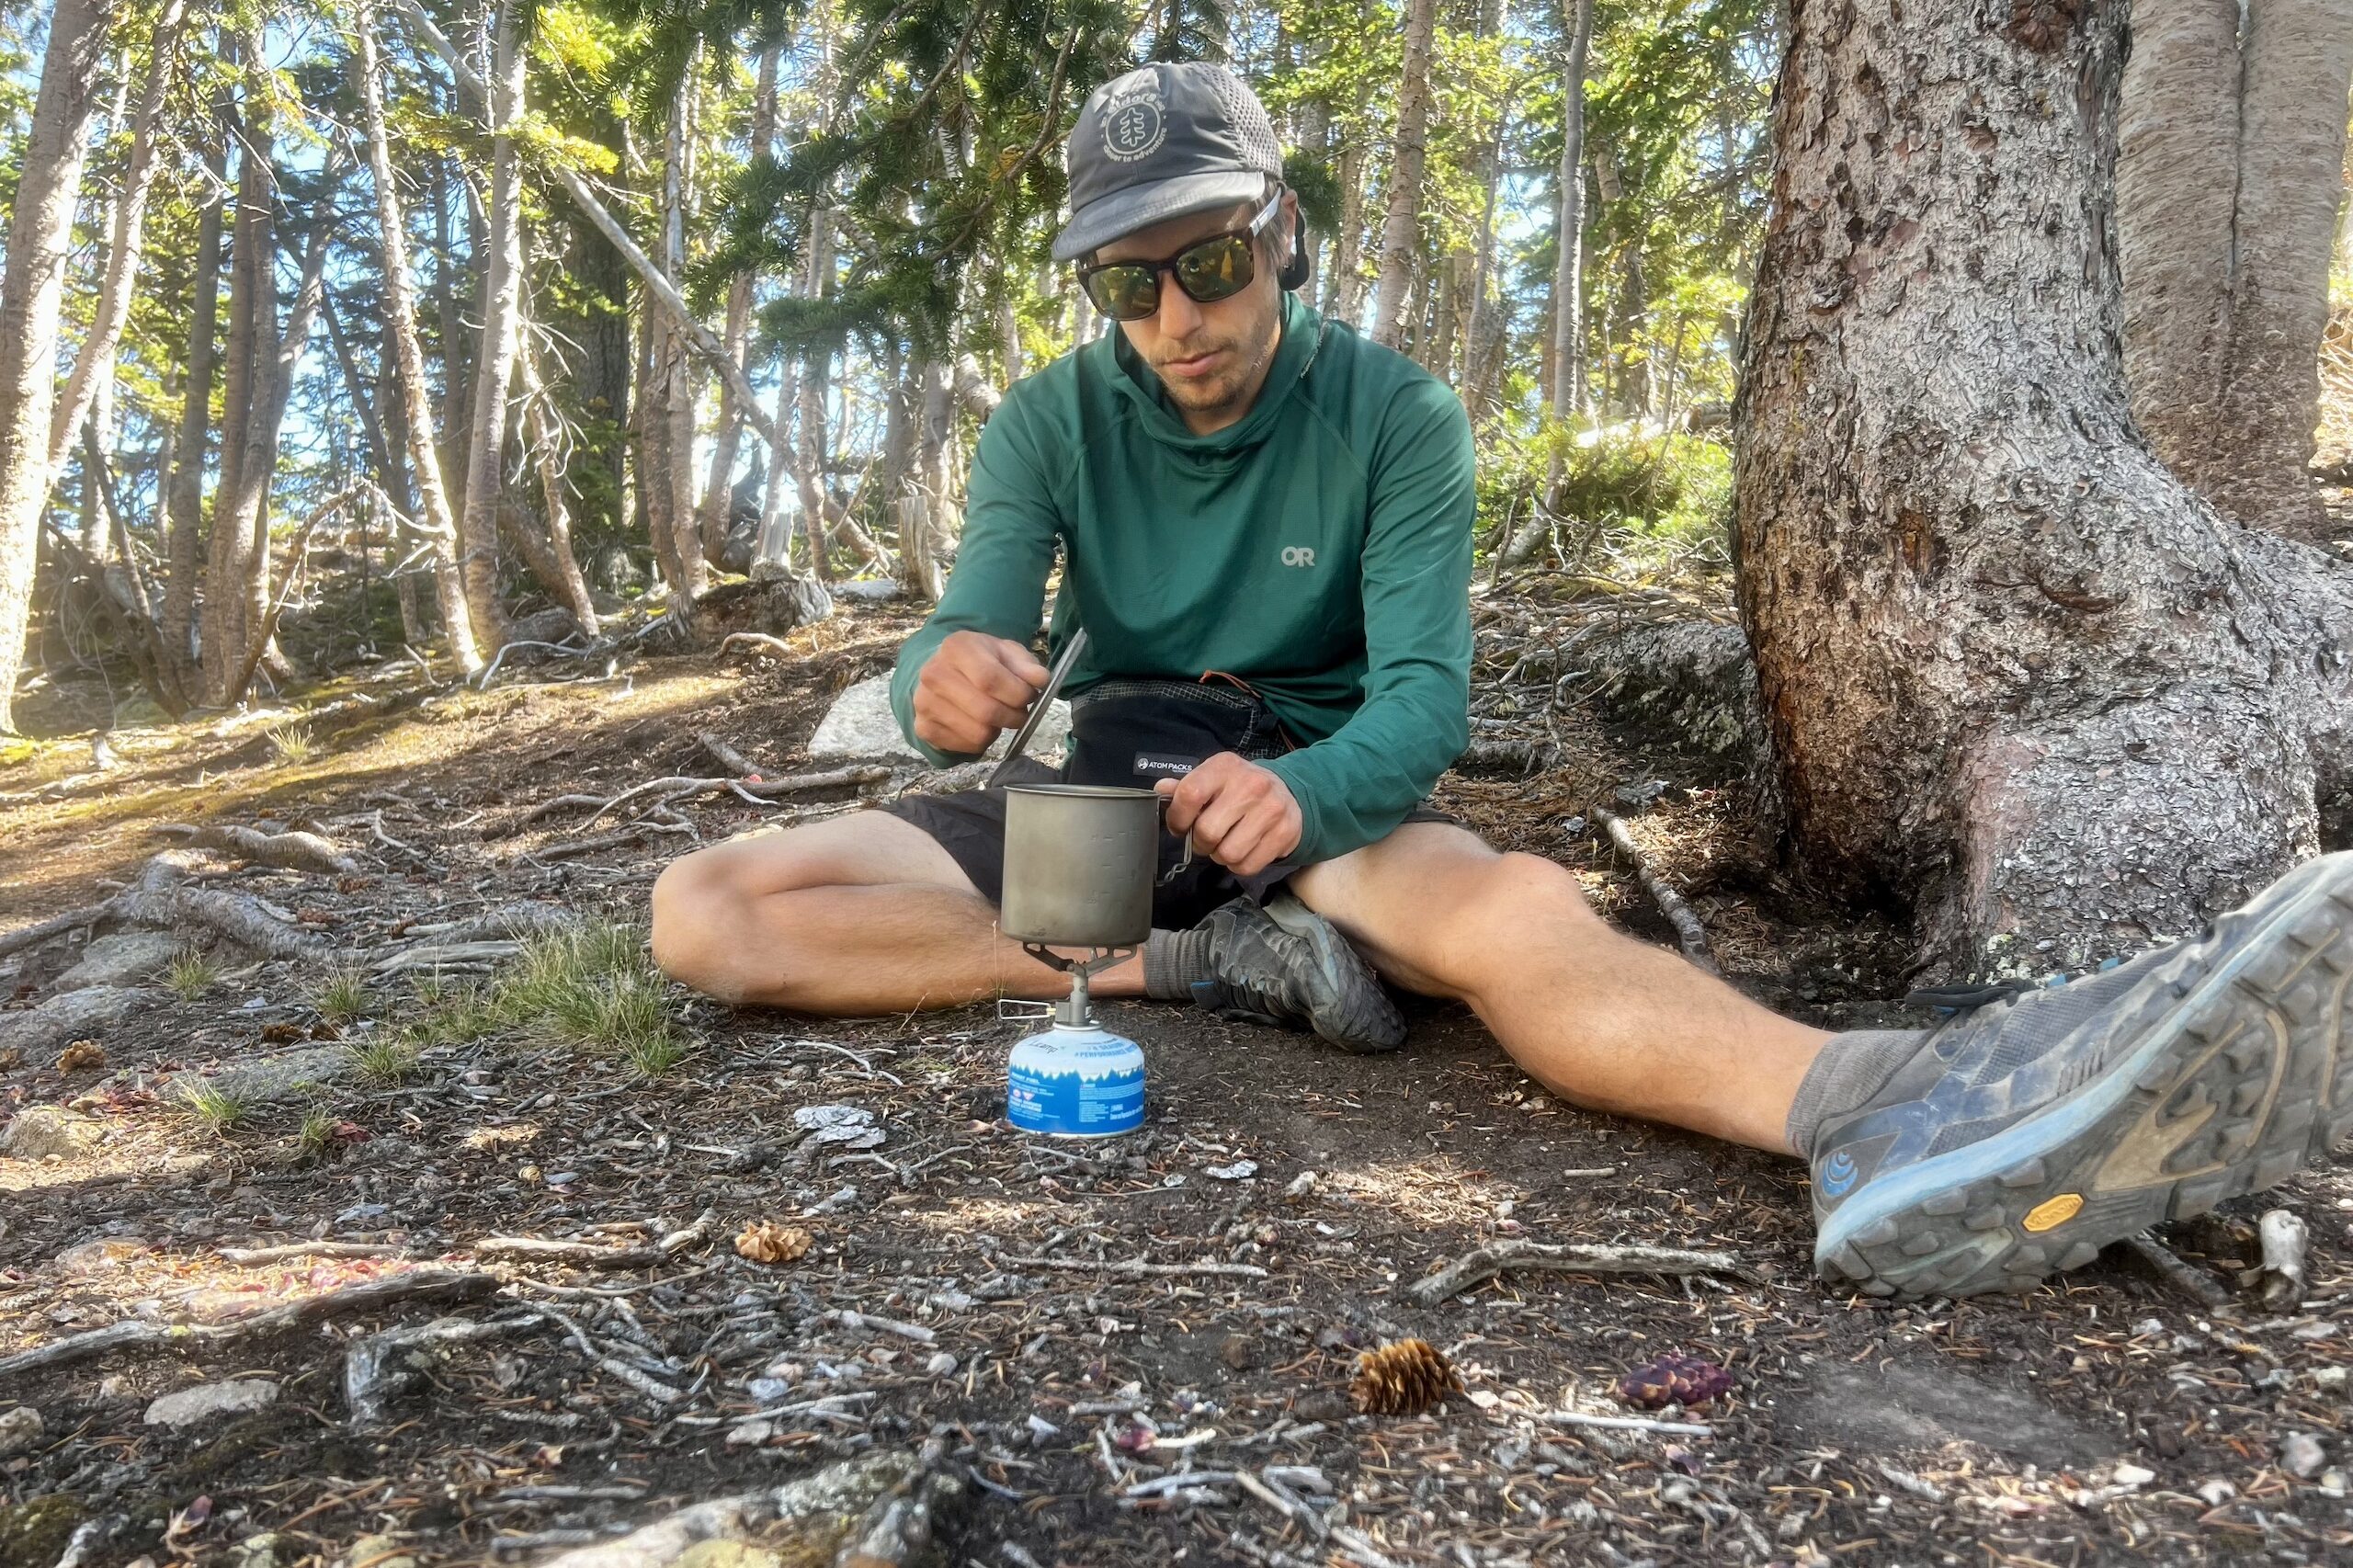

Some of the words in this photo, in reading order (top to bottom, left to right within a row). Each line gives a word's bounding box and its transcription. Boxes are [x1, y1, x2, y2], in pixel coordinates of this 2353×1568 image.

[1132, 127, 1168, 161] adventure
[1280, 546, 1315, 568] OR
[1148, 761, 1168, 769] ATOM
[1168, 762, 1193, 771] PACKS
